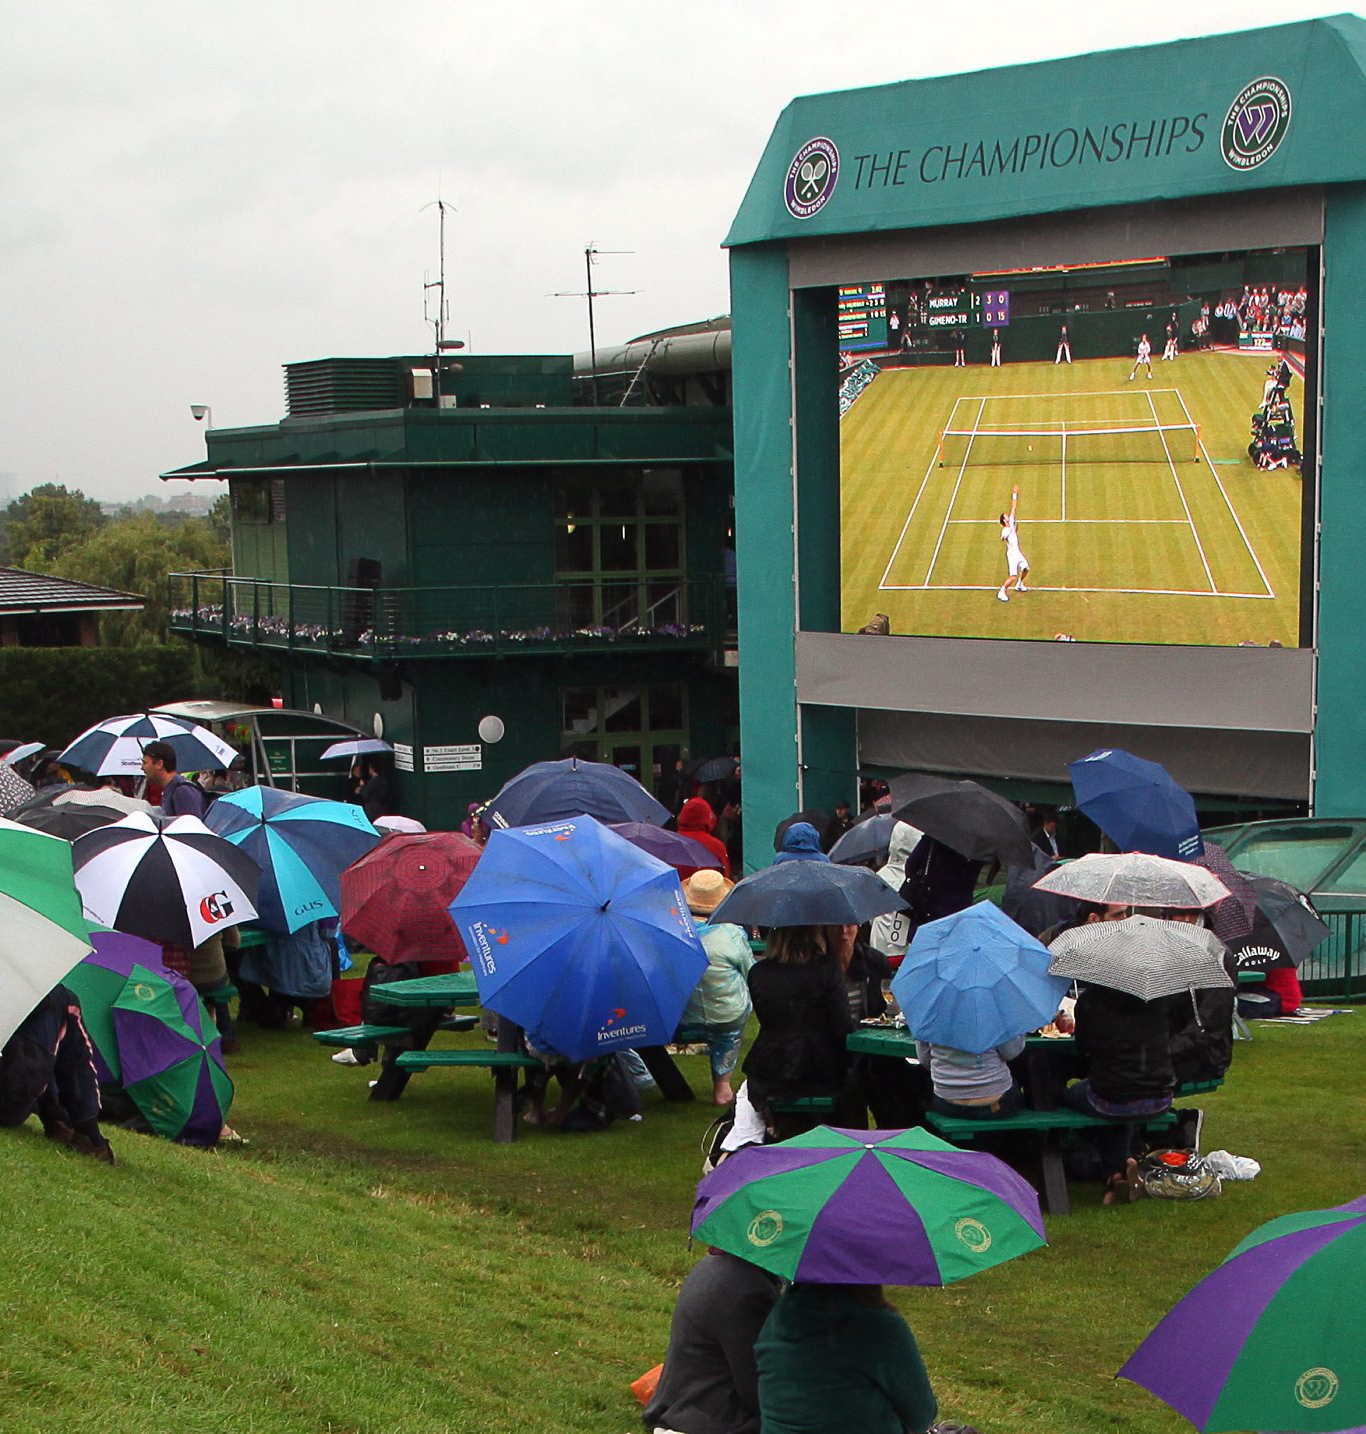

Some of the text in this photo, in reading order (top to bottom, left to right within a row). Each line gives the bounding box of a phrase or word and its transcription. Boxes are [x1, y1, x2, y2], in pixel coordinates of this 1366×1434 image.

[1239, 82, 1288, 118] CHAMPIONSHIPS
[798, 141, 837, 173] CHAMPIONSHIPS
[853, 112, 1209, 190] THE CHAMPIONSHIPS
[1228, 143, 1274, 166] WIMBLEDON
[929, 294, 1004, 308] MURRAY 2 3 0
[929, 313, 967, 326] GIMENO-TR
[986, 313, 992, 322] 0
[998, 312, 1005, 321] 15
[294, 900, 324, 916] GUS
